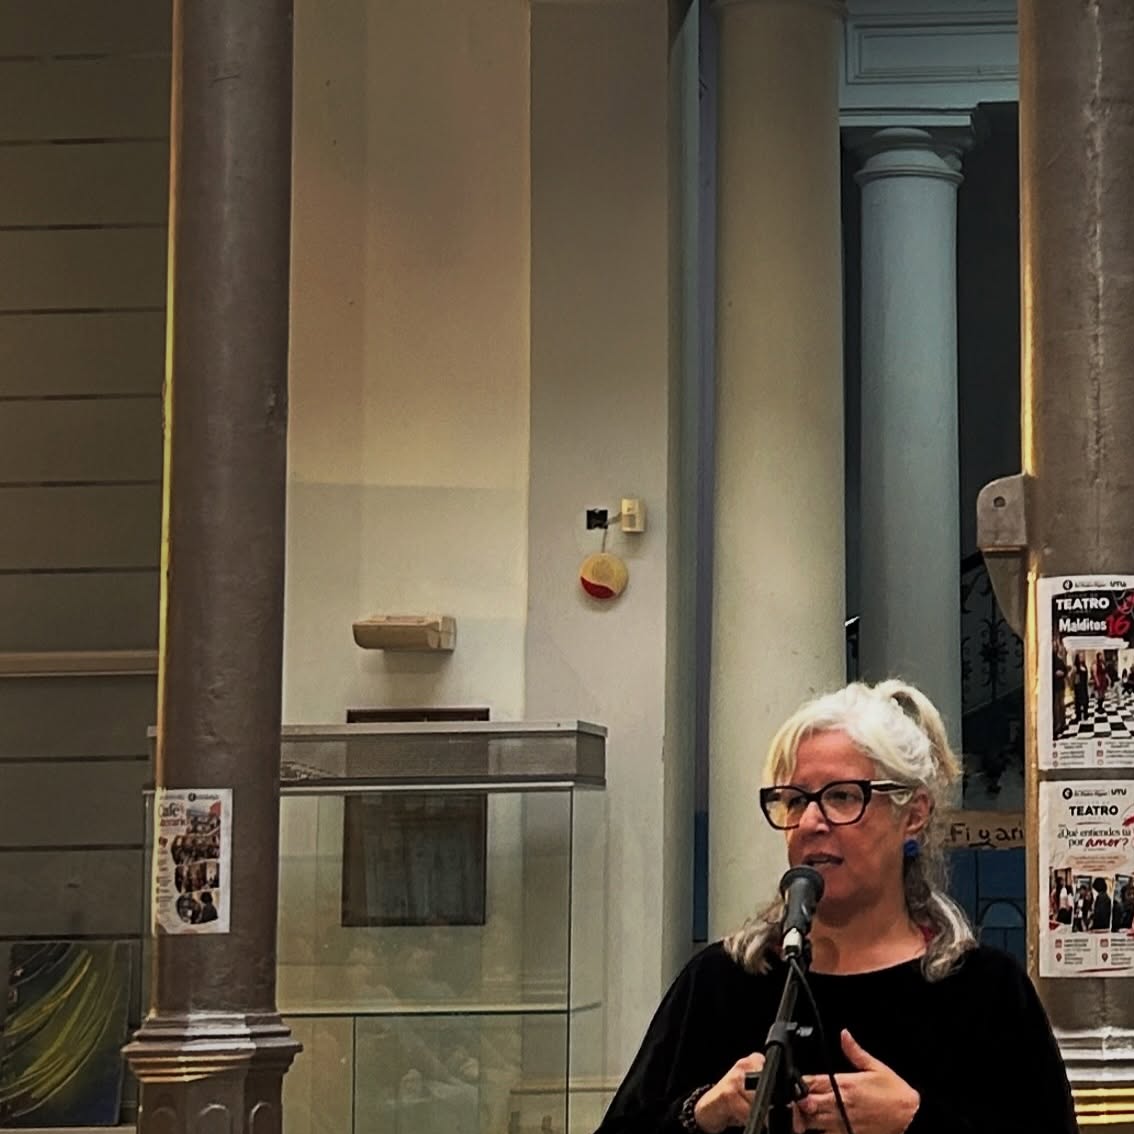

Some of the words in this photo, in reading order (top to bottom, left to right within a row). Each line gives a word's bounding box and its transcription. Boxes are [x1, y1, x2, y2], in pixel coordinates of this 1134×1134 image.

[1056, 597, 1110, 611] TEATRO
[1058, 617, 1107, 632] Malditos
[1069, 805, 1119, 817] TEATRO
[1080, 826, 1121, 837] entiendes
[1068, 838, 1084, 849] por
